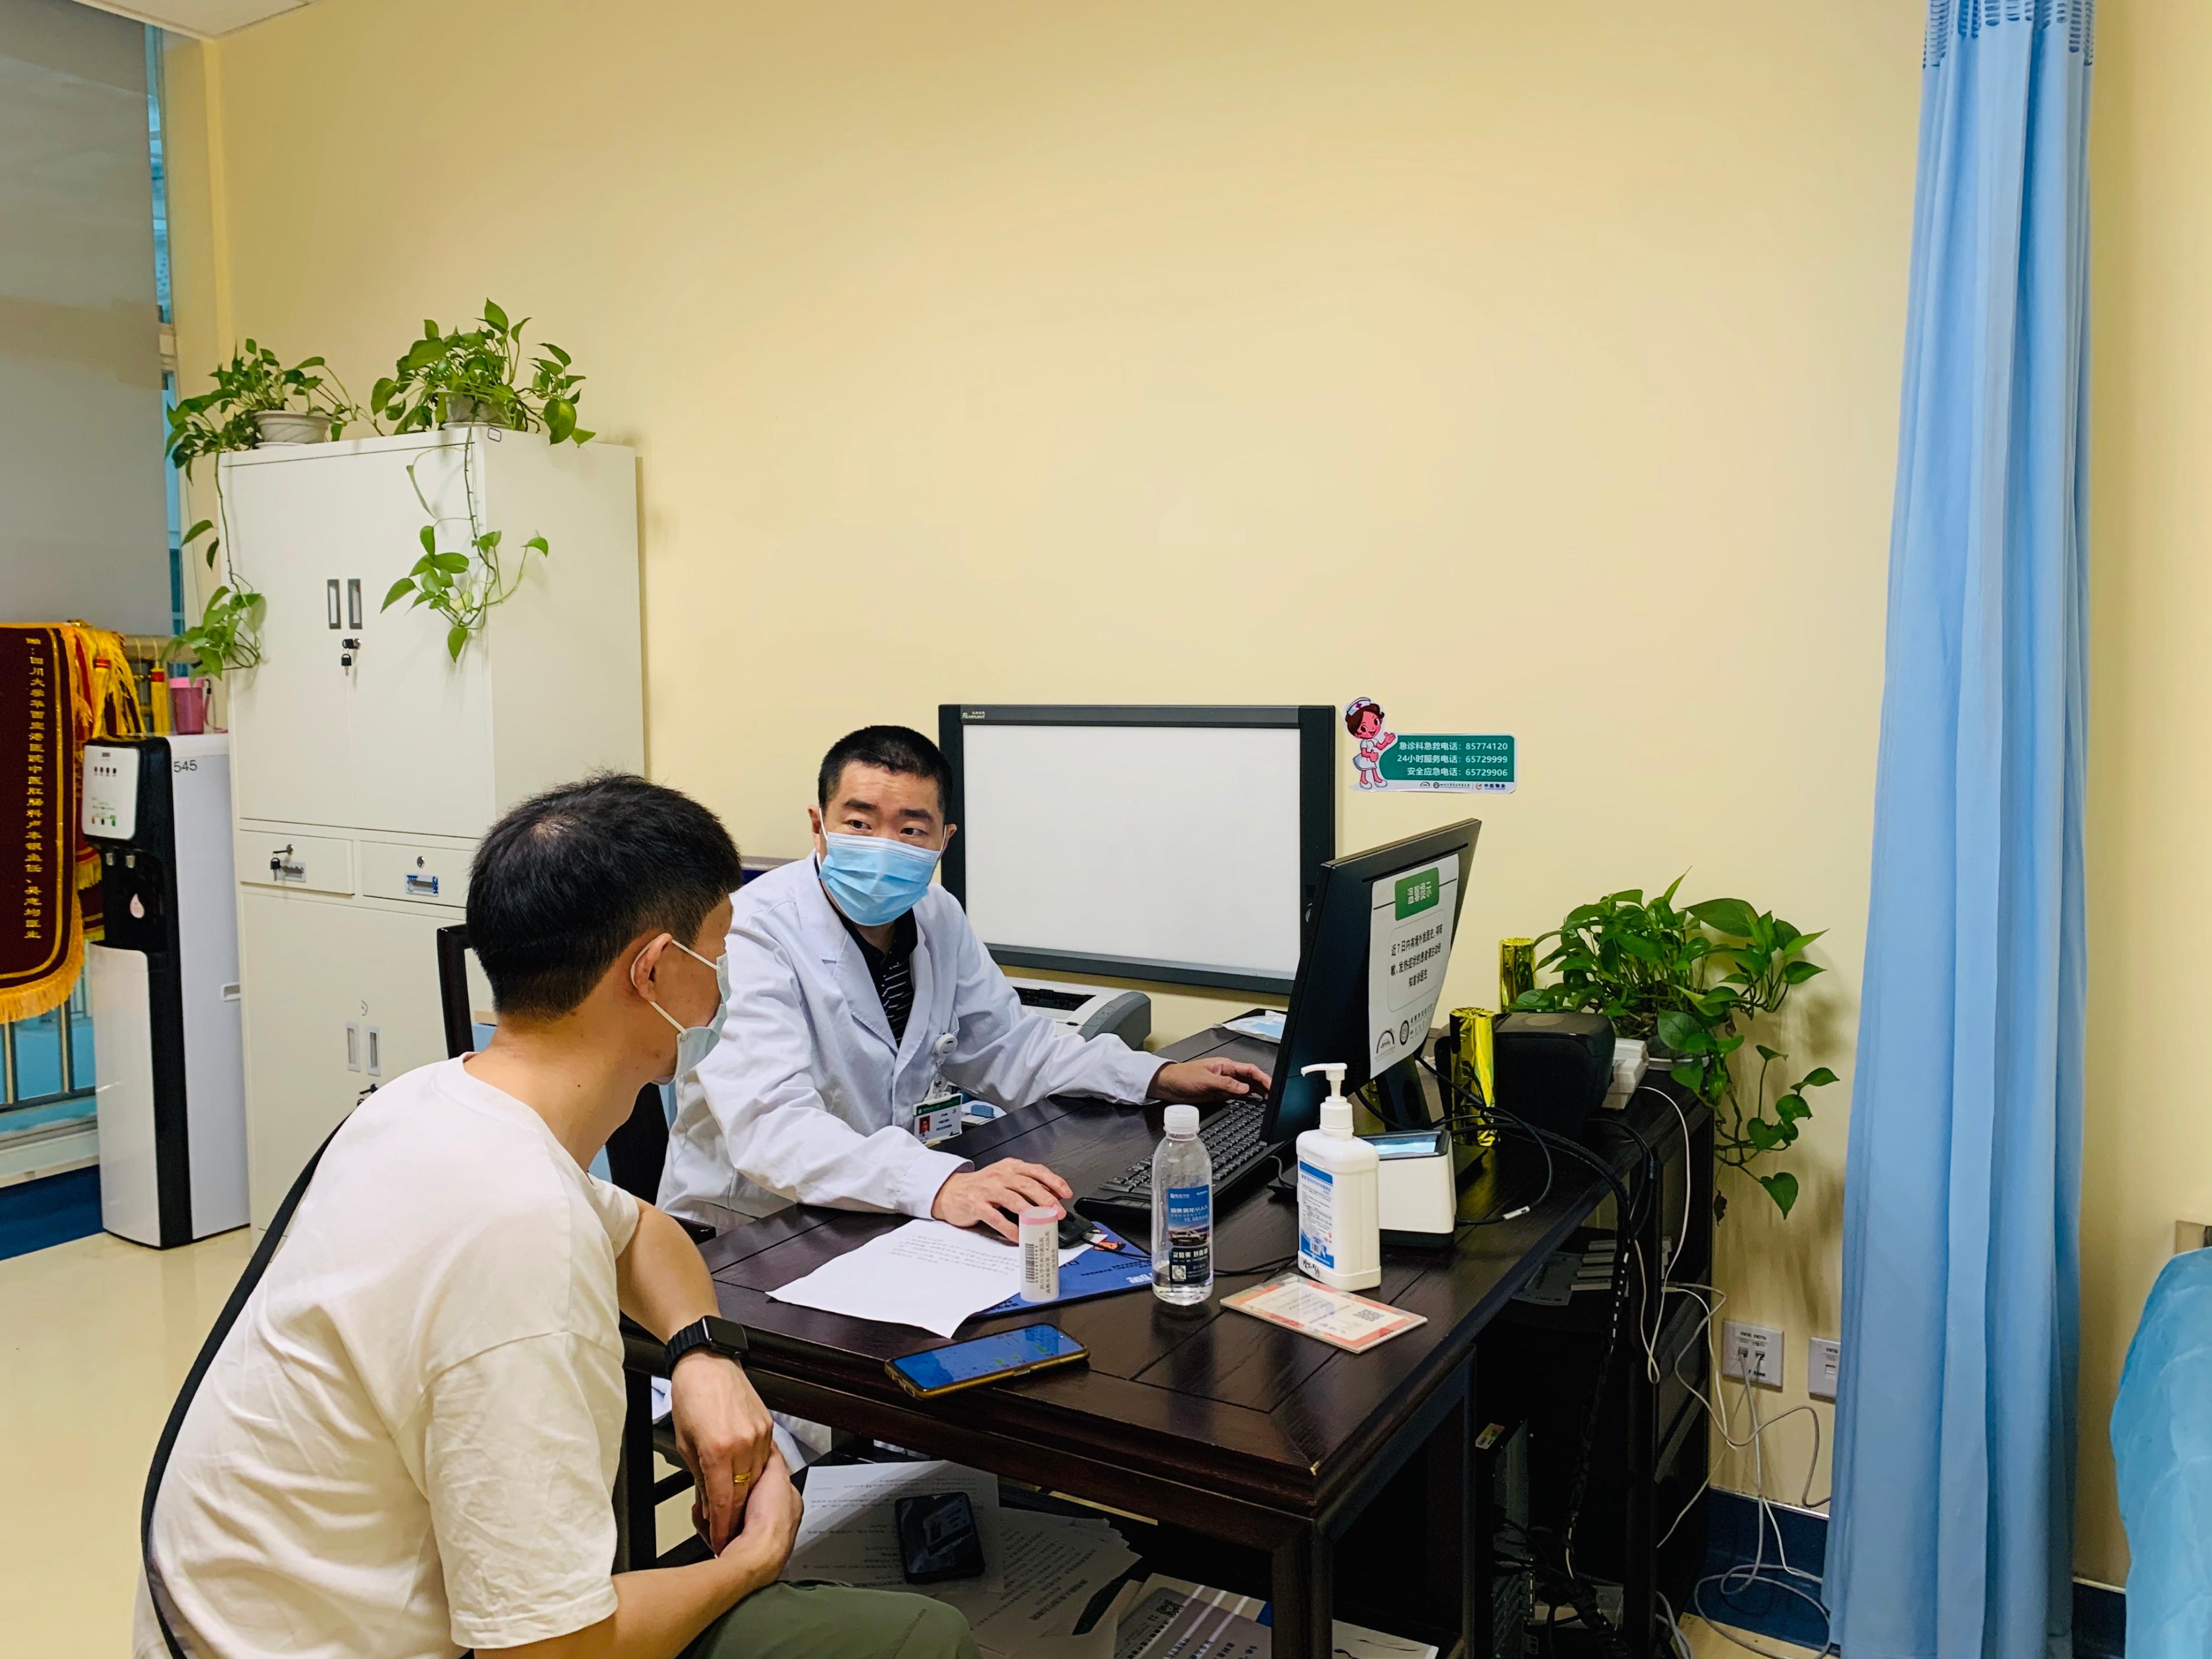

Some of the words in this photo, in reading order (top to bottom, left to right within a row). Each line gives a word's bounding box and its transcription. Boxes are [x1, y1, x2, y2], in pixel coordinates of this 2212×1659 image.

[1397, 754, 1461, 763] 24小时服务电话：
[174, 760, 197, 773] 545
[1407, 767, 1461, 776] 安全应急电话：
[1407, 882, 1432, 904] 温馨提示
